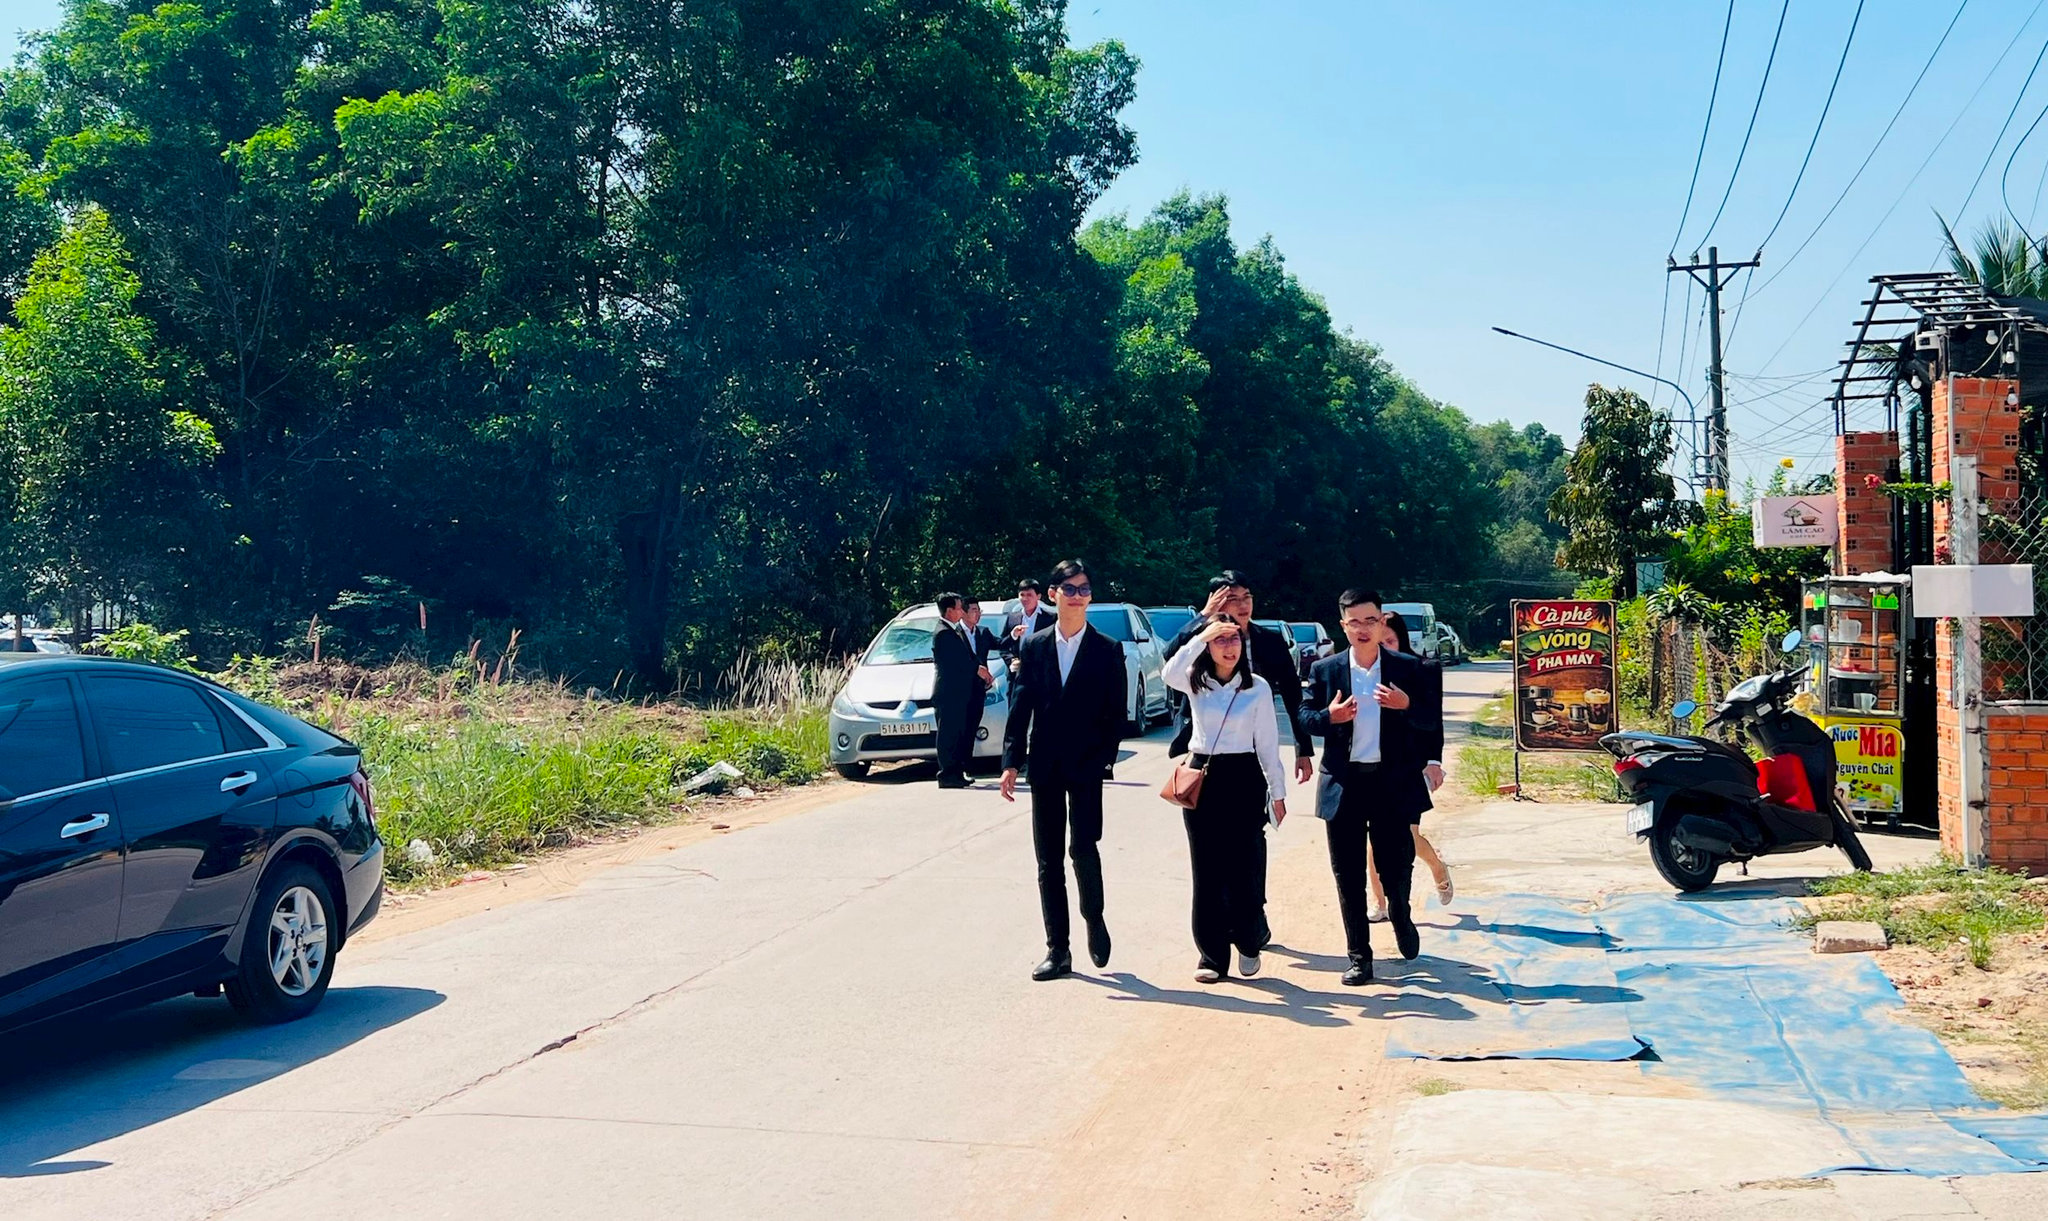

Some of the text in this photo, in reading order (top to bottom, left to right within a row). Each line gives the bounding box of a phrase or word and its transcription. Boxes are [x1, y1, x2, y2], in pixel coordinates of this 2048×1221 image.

[1533, 605, 1594, 626] Cà phê
[1537, 651, 1595, 671] PHA MÁY
